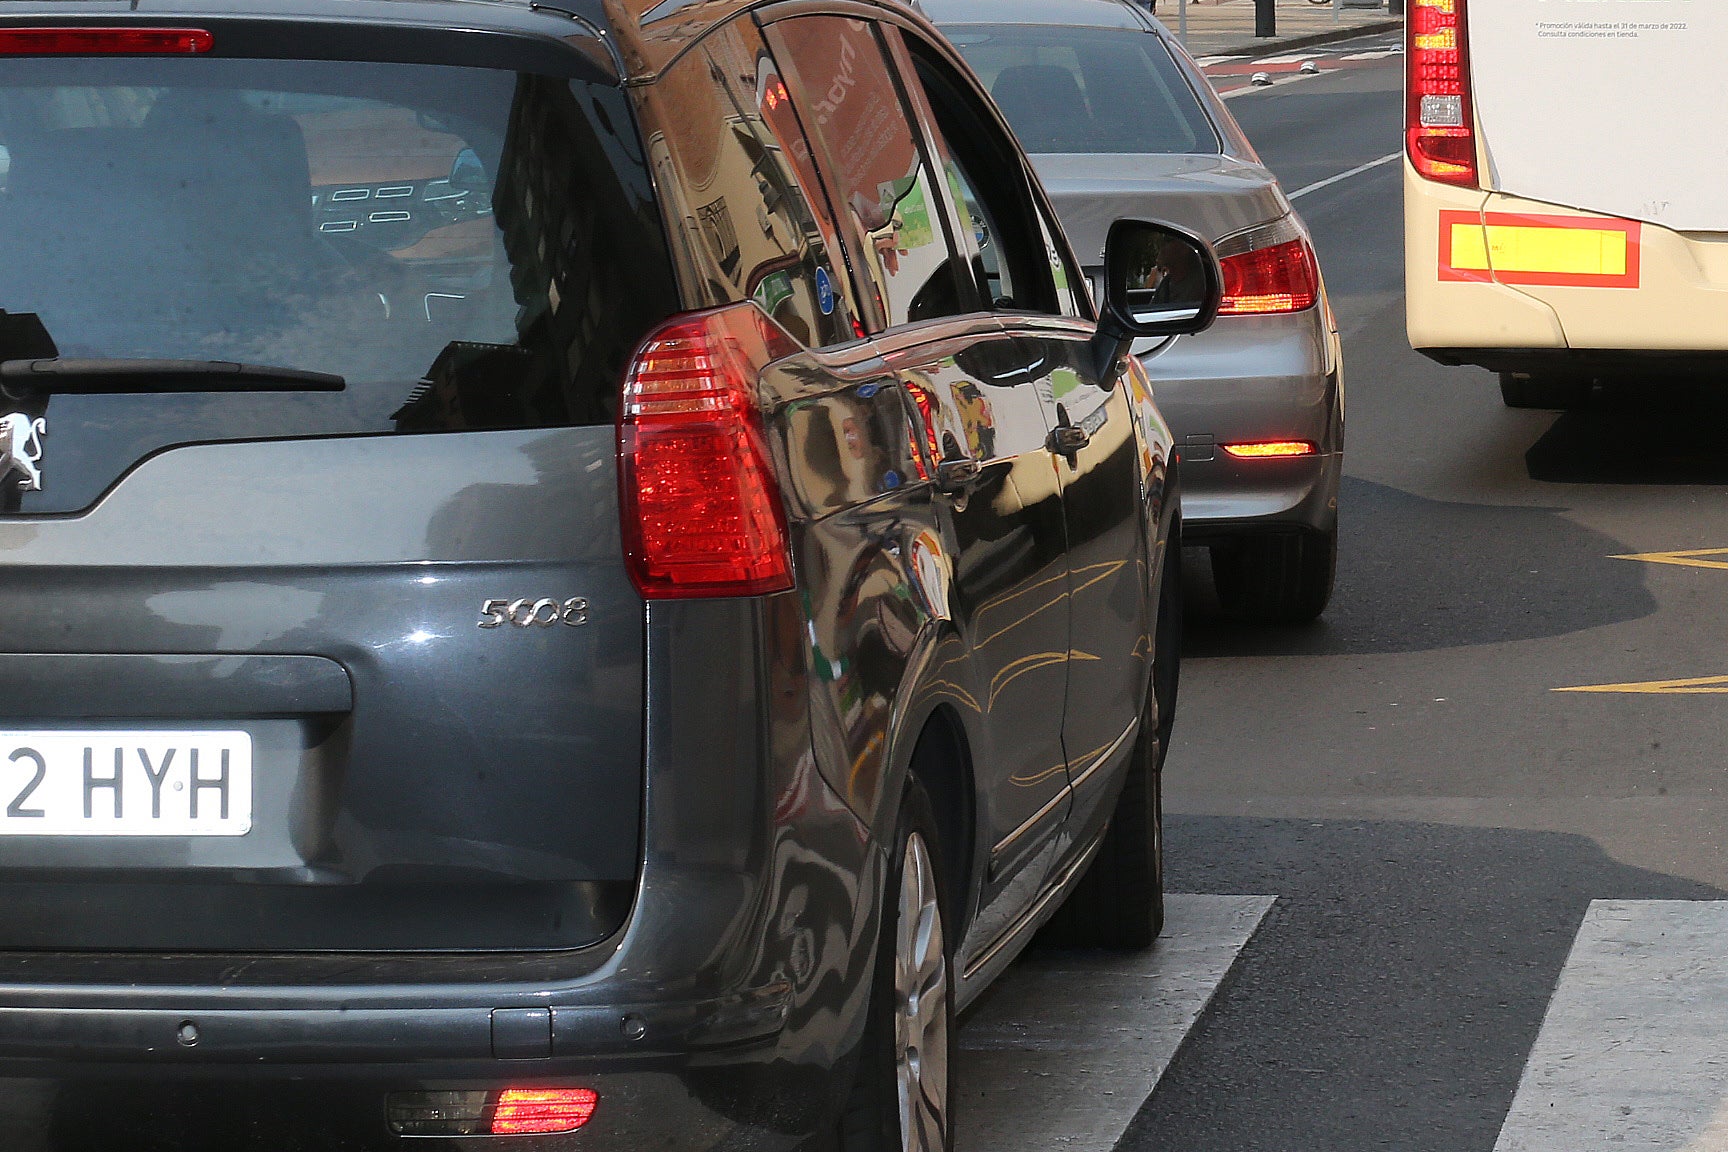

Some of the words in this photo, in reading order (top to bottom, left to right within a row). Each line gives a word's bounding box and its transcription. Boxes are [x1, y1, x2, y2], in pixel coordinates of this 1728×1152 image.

[476, 595, 590, 629] 5008
[6, 746, 47, 819] 2
[82, 746, 231, 820] HYH
